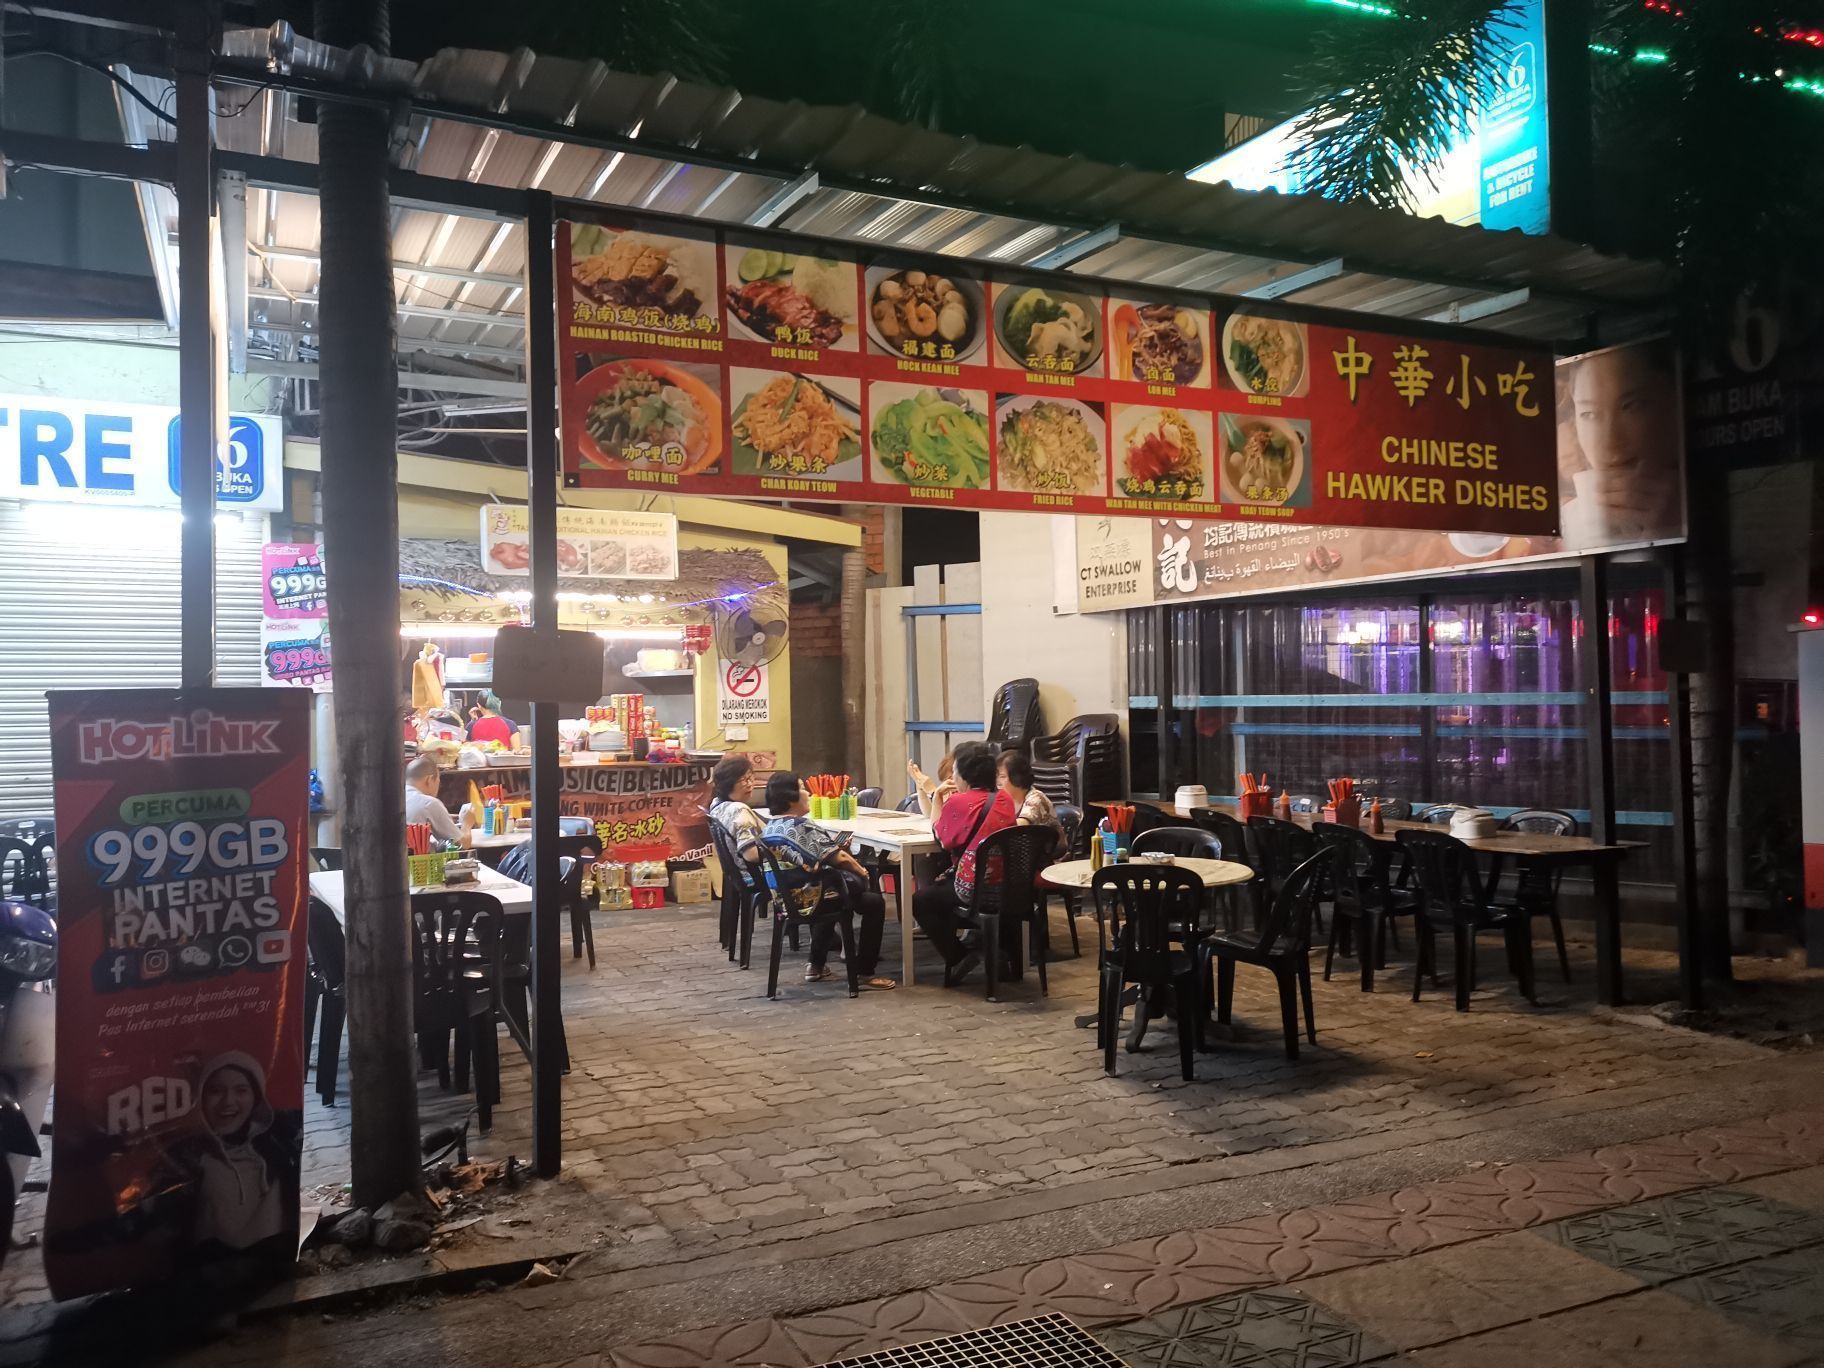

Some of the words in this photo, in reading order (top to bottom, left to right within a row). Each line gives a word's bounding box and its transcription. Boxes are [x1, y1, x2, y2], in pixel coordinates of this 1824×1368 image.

[570, 325, 608, 341] HAINAN
[610, 329, 657, 345] ROASTED
[657, 334, 700, 350] CHICKEN
[700, 338, 724, 352] RICE
[775, 324, 814, 347] 鸭饭
[770, 346, 797, 360] DUCK
[797, 348, 819, 361] RICE
[901, 339, 956, 360] 福建面
[896, 359, 921, 373] HOCK
[943, 364, 961, 377] MEE
[1025, 353, 1075, 372] 云吞面
[1025, 372, 1044, 384] WAN
[1045, 374, 1060, 386] TAN
[1060, 376, 1076, 388] MEE
[1332, 335, 1541, 417] 中華小吃
[1161, 387, 1177, 398] MEE
[1727, 378, 1785, 415] BUKA
[1740, 414, 1786, 443] OPEN
[0, 407, 134, 490] RE
[621, 443, 684, 466] 咖哩面
[1381, 435, 1499, 470] CHINESE
[627, 468, 661, 484] CURRY
[660, 471, 680, 486] MEE
[913, 463, 949, 482] 炒菜
[1034, 471, 1071, 489] 炒饭
[760, 477, 786, 490] CHAR
[786, 479, 810, 492] KOAY
[811, 481, 838, 494] TEOW
[909, 486, 955, 500] VEGETABLE
[1125, 478, 1205, 498] 烧鸡云吞面
[1327, 471, 1446, 504] HAWKER
[1455, 479, 1549, 511] DISHES
[1033, 494, 1055, 506] FRIED
[1055, 495, 1074, 507] RICE
[1105, 498, 1123, 509] WAN
[1123, 499, 1138, 510] TAN
[1138, 500, 1153, 511] MEE
[1153, 501, 1172, 512] WITH
[1173, 502, 1204, 513] CHICKEN
[1204, 503, 1222, 514] MEAT
[1239, 505, 1258, 516] KOAY
[1258, 506, 1277, 518] TEOW
[1277, 507, 1296, 519] SOUP
[1203, 549, 1223, 560] Best
[1226, 547, 1236, 556] in
[1239, 540, 1277, 555] Penang
[1281, 534, 1311, 548] Since
[1316, 527, 1351, 542] 1950's
[1080, 567, 1092, 581] CT
[1093, 559, 1142, 579] SWALLOW
[270, 572, 327, 597] 999G
[1085, 579, 1138, 599] ENTERPRISE
[269, 646, 329, 673] 999G
[722, 699, 745, 710] DILARANG
[722, 712, 733, 720] NO
[734, 711, 768, 720] SMOKING
[586, 769, 618, 794] ICE
[622, 765, 713, 794] BLENDED
[132, 793, 242, 819] PERCUMA
[583, 800, 624, 817] WHITE
[625, 796, 674, 811] COFFEE
[92, 818, 290, 884] 999GB
[112, 867, 279, 914] INTERNET
[113, 895, 281, 947] PANTAS
[105, 1002, 150, 1018] dengan
[153, 994, 194, 1010] setiap
[192, 984, 261, 1012] pembelian
[98, 1023, 123, 1037] Pas
[125, 1013, 179, 1033] Internet
[179, 1004, 240, 1025] serendah
[106, 1075, 192, 1136] RED
